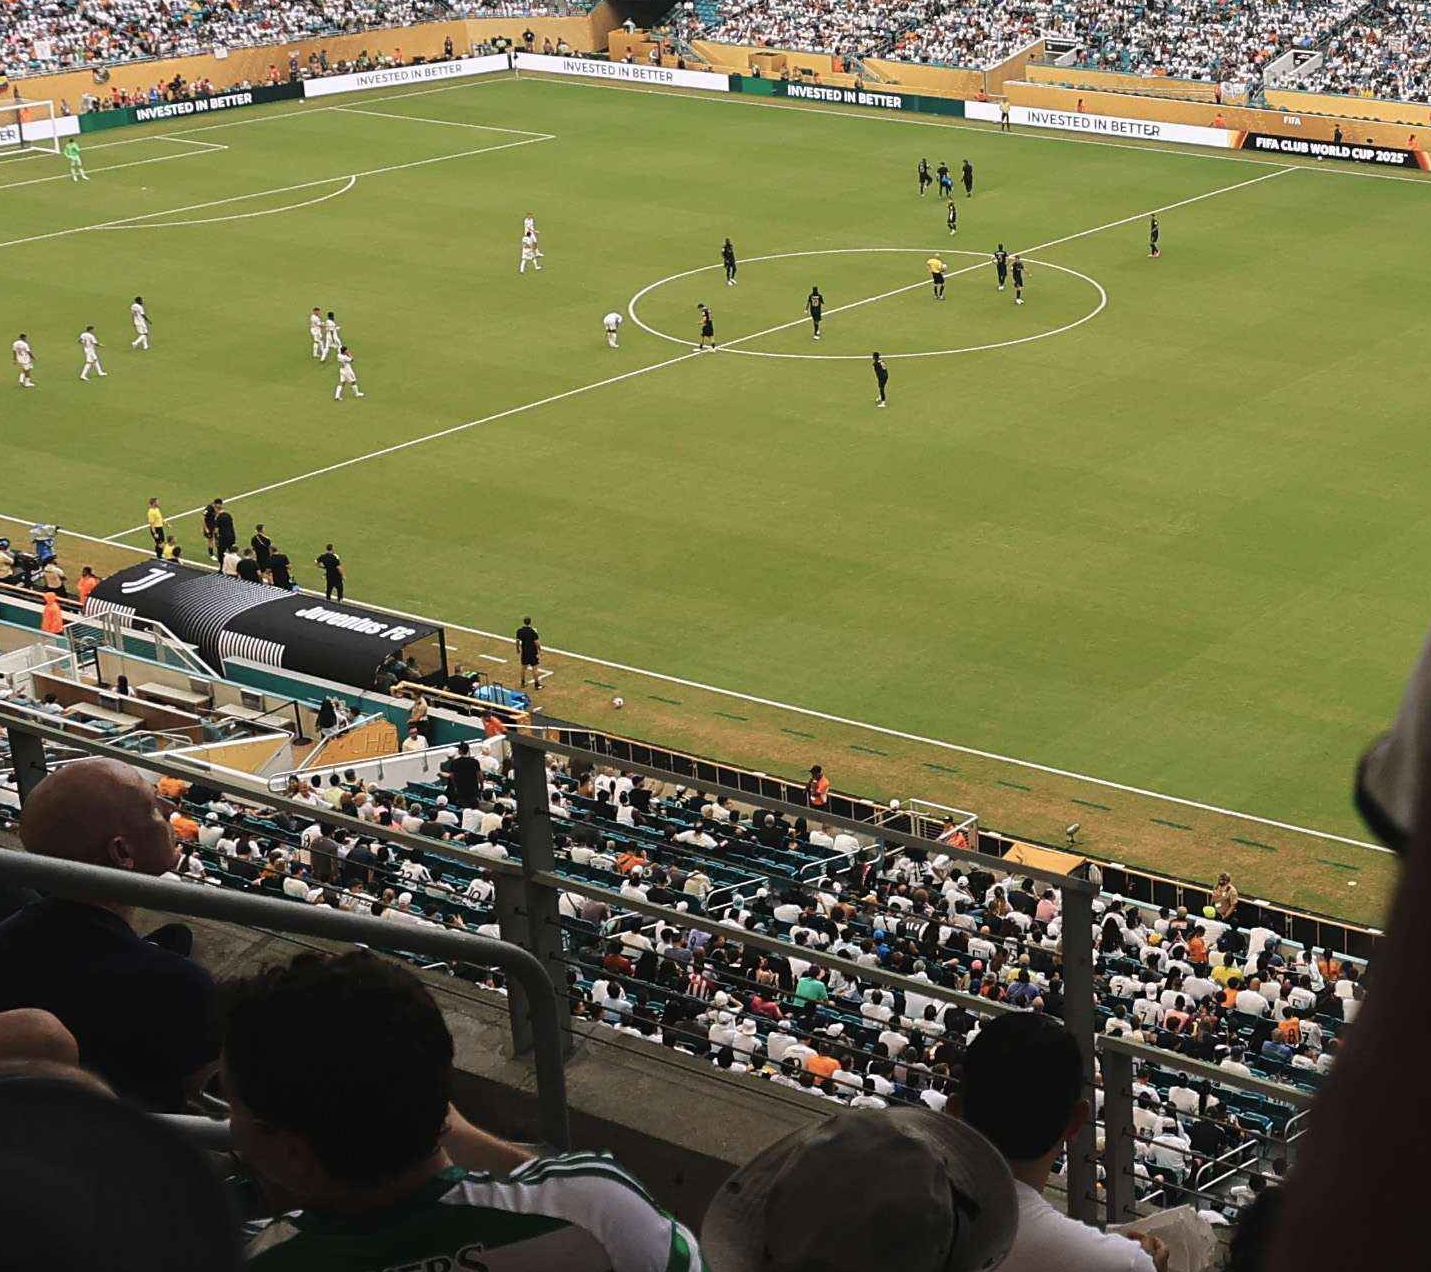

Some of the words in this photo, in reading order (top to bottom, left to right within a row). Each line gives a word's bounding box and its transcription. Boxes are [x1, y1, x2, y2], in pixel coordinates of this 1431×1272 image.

[357, 70, 408, 86] INVESTED
[412, 70, 421, 79] IN
[424, 64, 462, 77] BETTER
[563, 61, 615, 75] INVESTED
[619, 67, 629, 77] IN
[632, 69, 673, 82] BETTER
[788, 85, 841, 103] INVESTED
[844, 91, 856, 103] IN
[858, 93, 901, 109] BETTER
[1028, 111, 1090, 129] INVESTED
[1095, 118, 1107, 131] IN
[1111, 120, 1160, 137] BETTER
[1284, 116, 1301, 126] FIFA
[1256, 137, 1280, 150] FIFA
[1282, 140, 1308, 153] CLUB
[1310, 142, 1350, 157] WORLD
[1352, 146, 1374, 160] CUP
[295, 606, 388, 635] Juventus
[379, 625, 416, 641] FC
